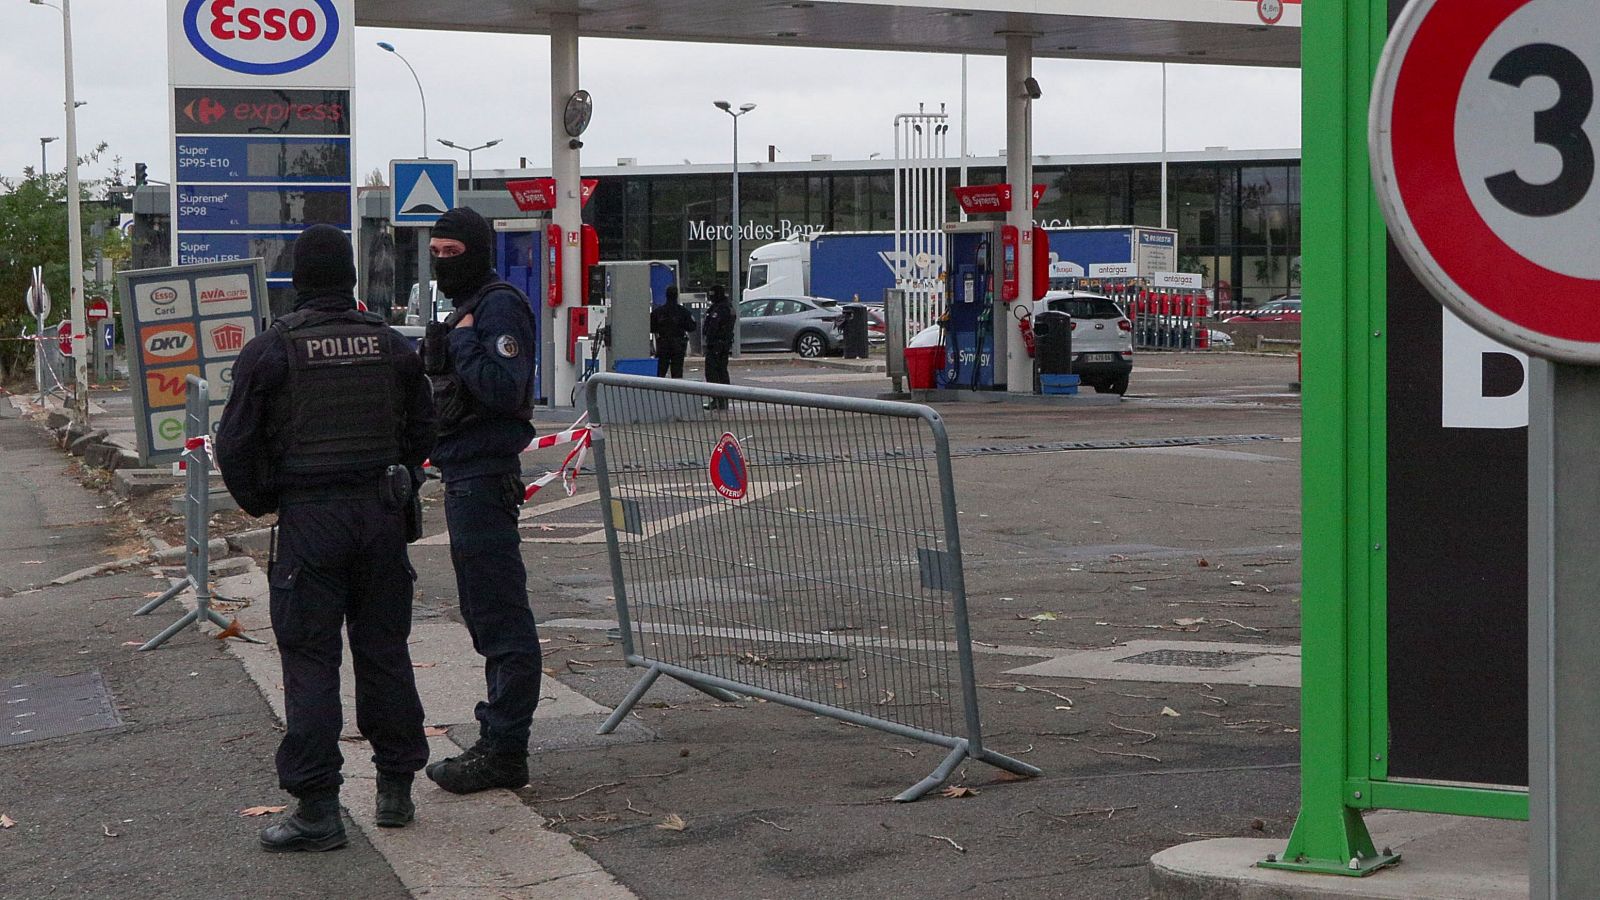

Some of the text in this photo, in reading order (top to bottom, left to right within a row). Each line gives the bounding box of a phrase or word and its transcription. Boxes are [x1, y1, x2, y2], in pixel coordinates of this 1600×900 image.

[209, 0, 317, 42] Esso
[233, 102, 344, 125] express
[1484, 42, 1595, 218] 3
[178, 145, 209, 156] Super
[179, 158, 230, 168] SP95-E10
[549, 185, 554, 195] 1
[582, 186, 590, 196] 2
[1004, 190, 1010, 199] 3
[1033, 190, 1040, 199] 4
[179, 192, 229, 205] Supreme+
[972, 196, 1000, 206] Synergy
[180, 206, 207, 216] SP98
[688, 219, 825, 241] Mercedes-Benz
[180, 241, 210, 254] Super
[180, 254, 218, 264] Ethanol
[1098, 266, 1127, 275] antargaz
[1163, 275, 1193, 285] antargaz
[154, 292, 174, 301] Esso
[200, 288, 247, 300] AVIA carte
[154, 306, 176, 316] Card
[213, 324, 245, 351] UTA
[149, 335, 188, 352] DKV
[306, 336, 380, 358] POLICE
[960, 350, 990, 366] Syngy
